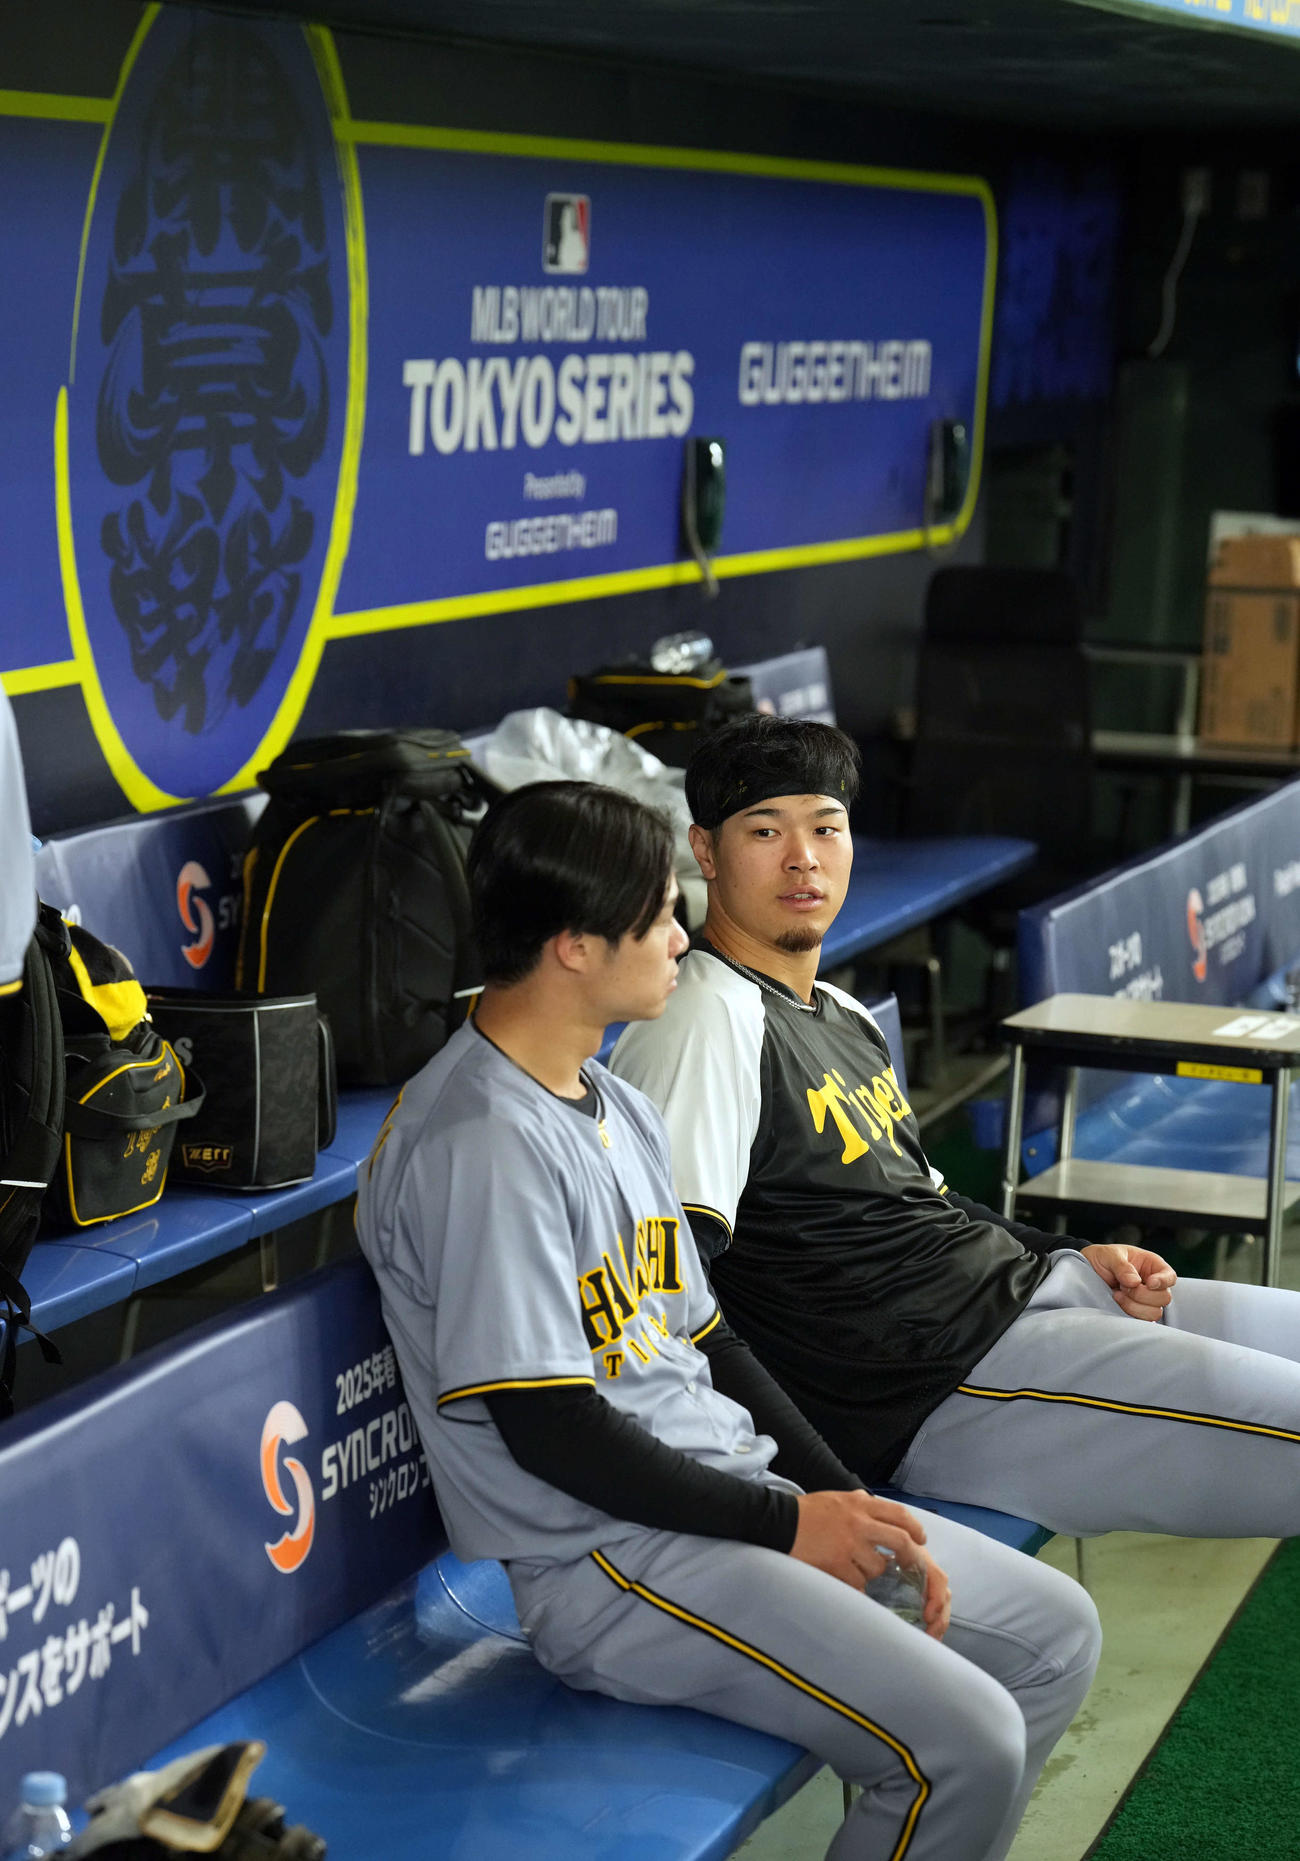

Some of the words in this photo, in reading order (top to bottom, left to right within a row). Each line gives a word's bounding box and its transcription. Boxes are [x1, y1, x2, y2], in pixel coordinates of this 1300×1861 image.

[471, 286, 519, 343] MLB
[520, 286, 597, 342] WORLD
[596, 286, 649, 341] TOUR
[402, 354, 555, 456] TOKYO
[556, 349, 695, 446] SERIES
[738, 338, 932, 406] GUGGENHEIM
[484, 508, 618, 561] GUGGENHEIM
